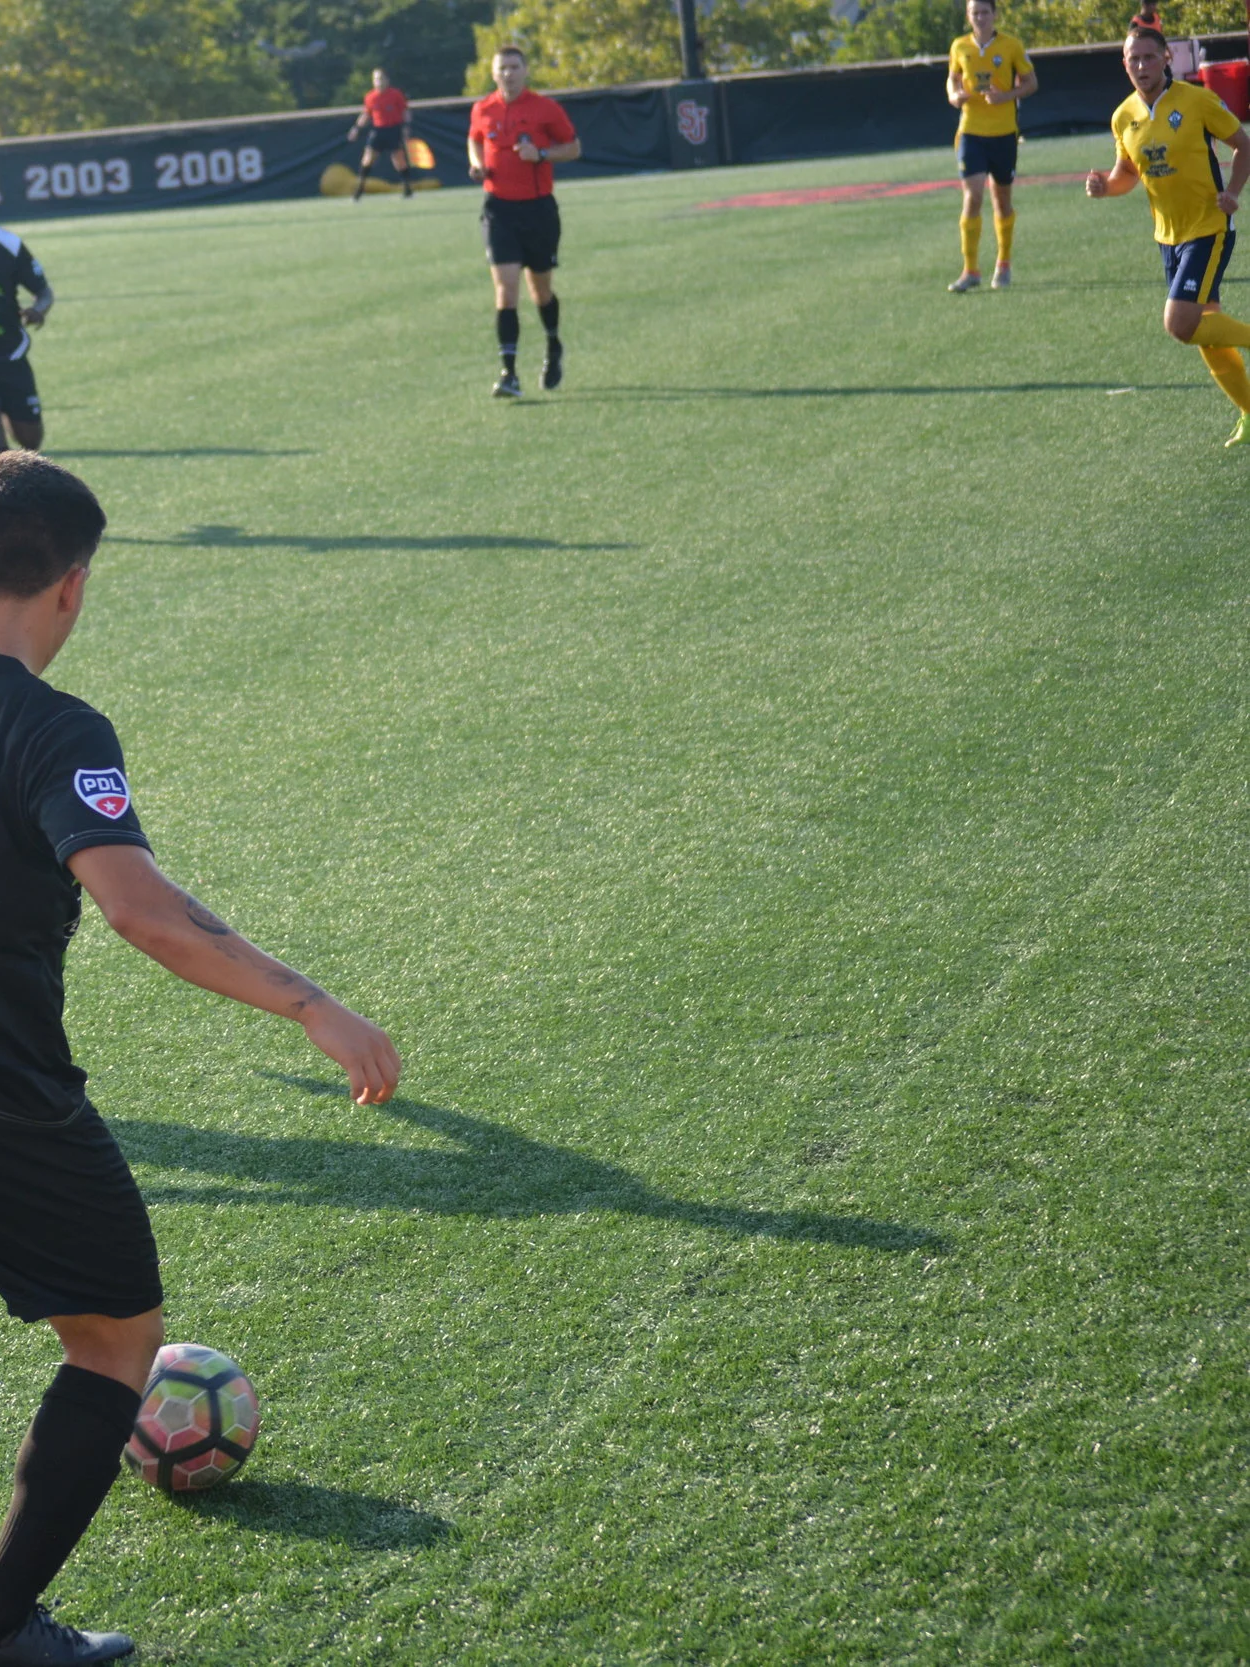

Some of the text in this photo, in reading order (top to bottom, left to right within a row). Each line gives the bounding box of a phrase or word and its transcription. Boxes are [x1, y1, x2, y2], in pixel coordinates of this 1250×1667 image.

[24, 157, 132, 200] 2003
[154, 146, 263, 190] 2008
[82, 777, 122, 792] PDL
